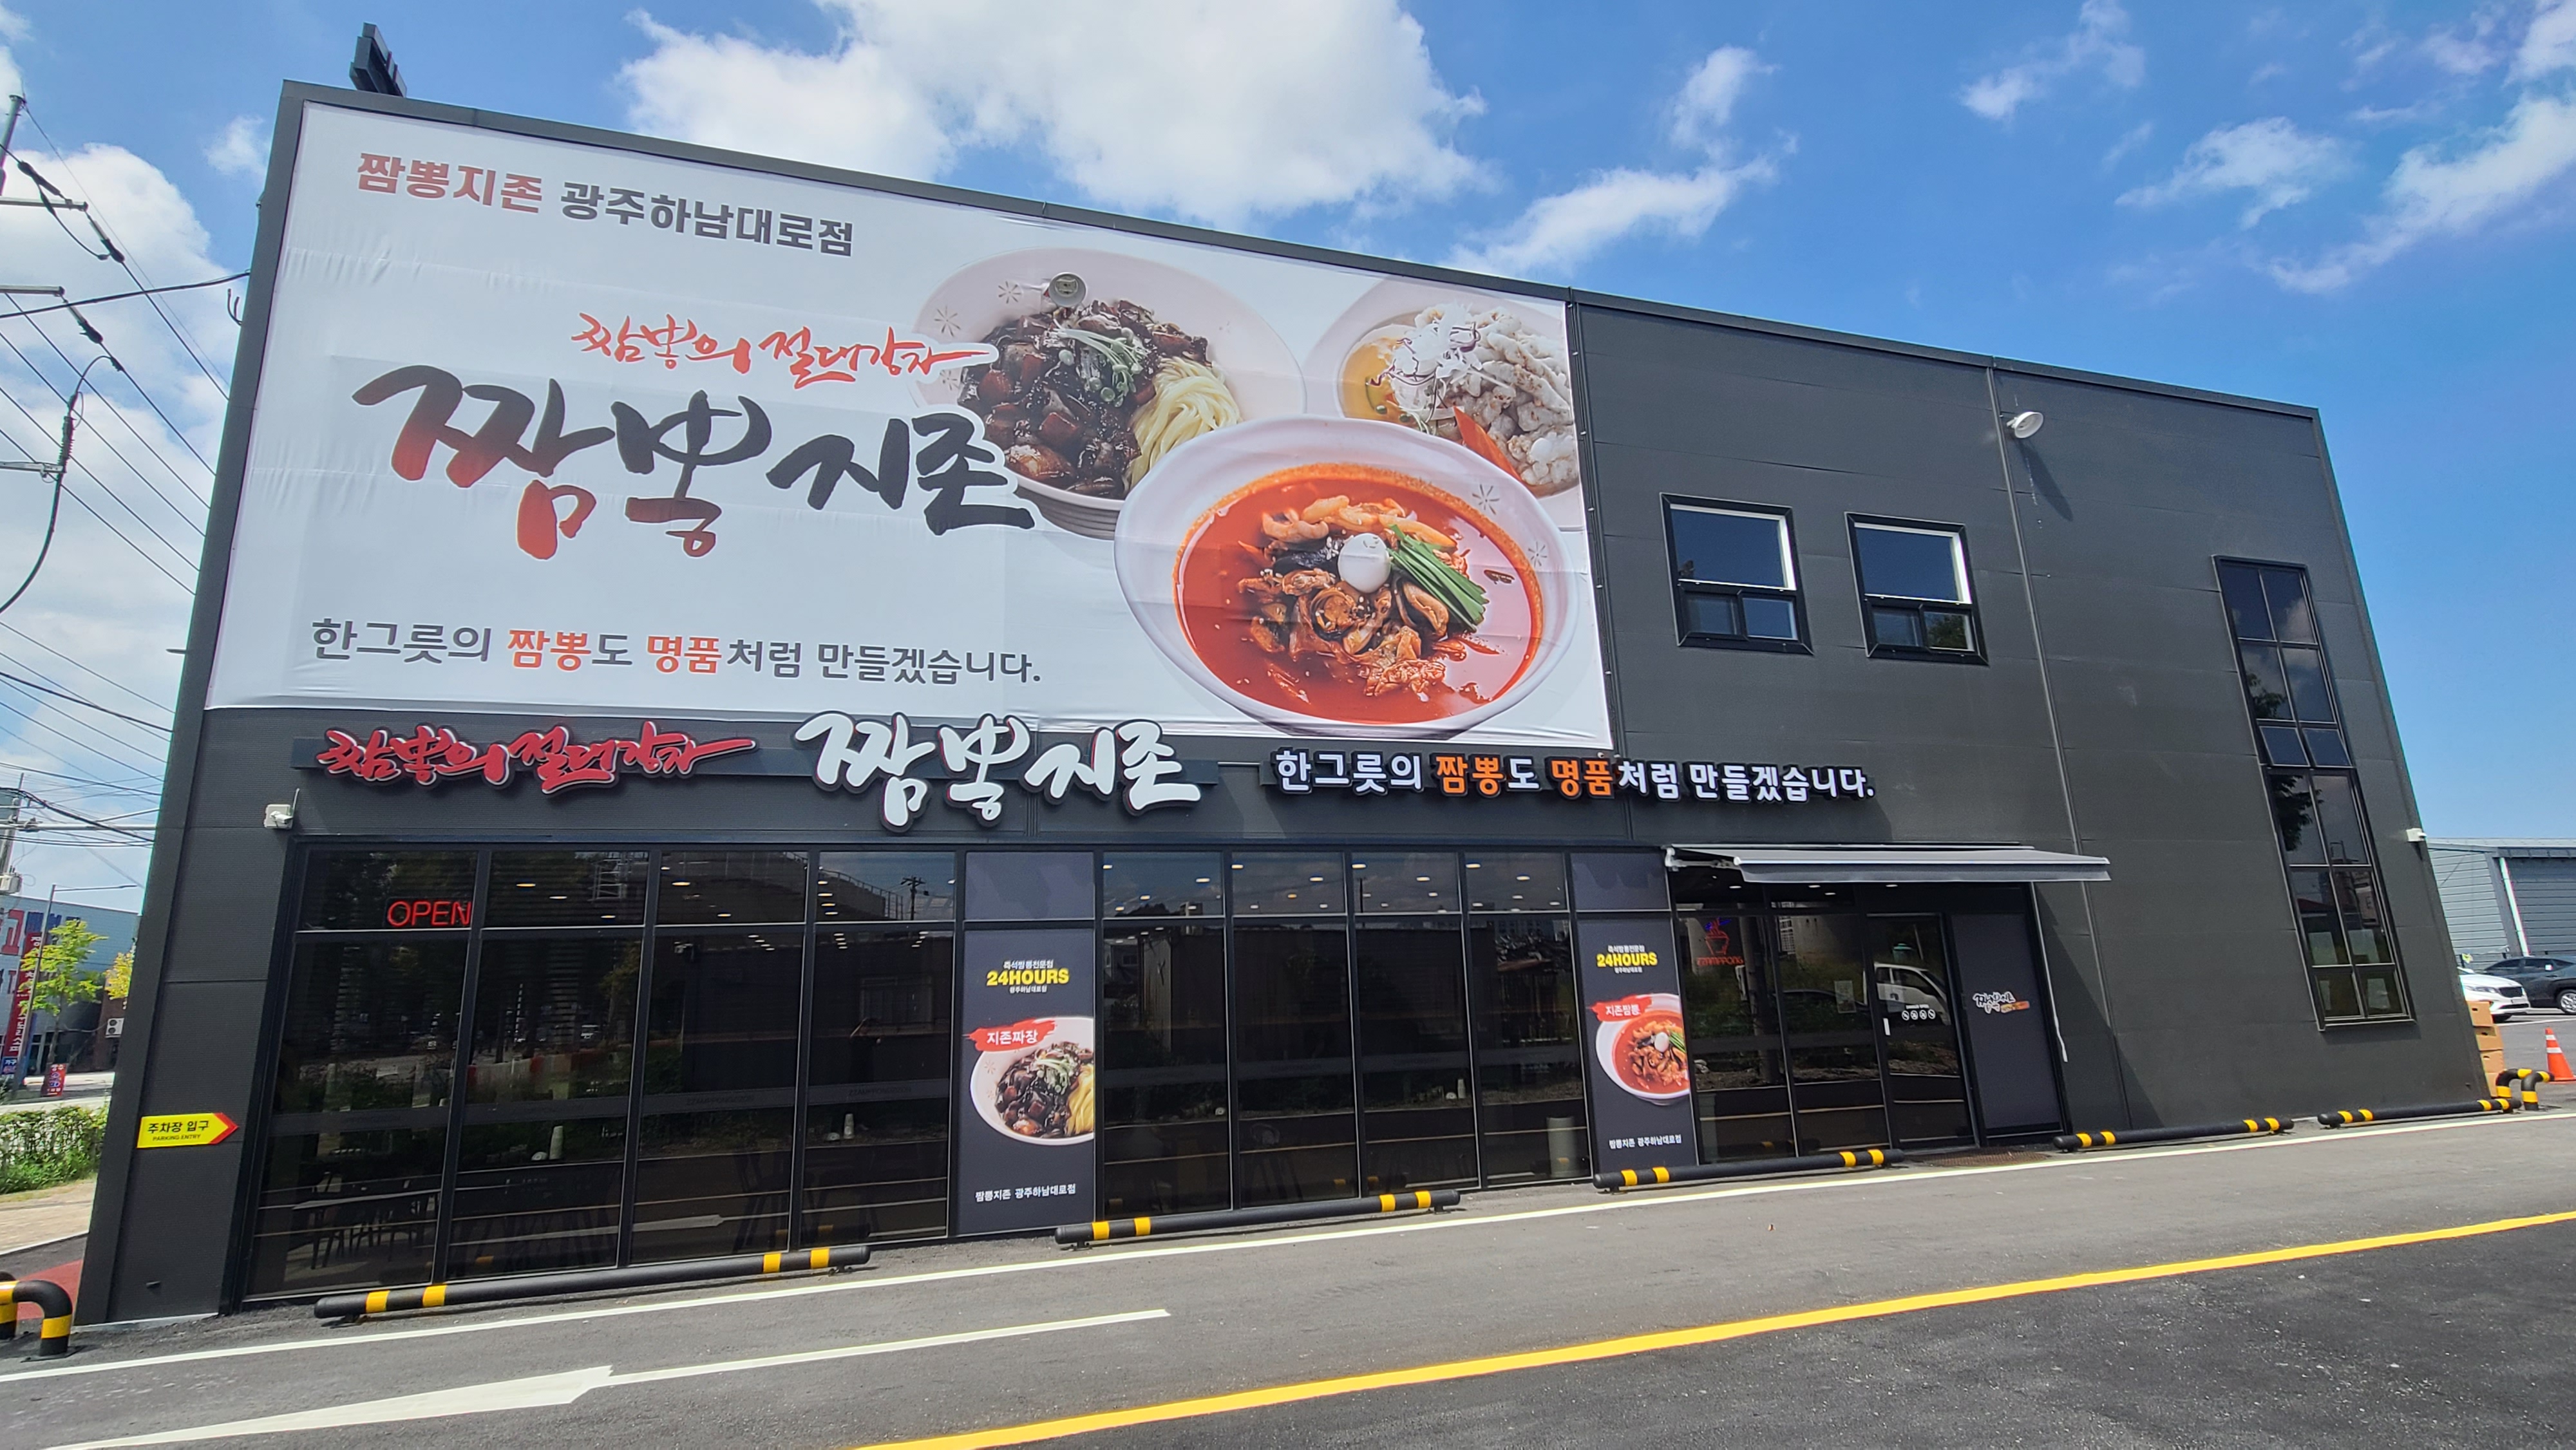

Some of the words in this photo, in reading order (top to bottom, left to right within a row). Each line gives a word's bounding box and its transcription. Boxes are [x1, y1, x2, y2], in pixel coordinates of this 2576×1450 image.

[357, 153, 542, 213] 짬뽕지존
[560, 181, 854, 256] 광주하남대로점
[571, 312, 750, 374] 짬뽕의
[758, 326, 989, 389] 절대강자
[352, 365, 1035, 560] 짬뽕지존
[312, 618, 492, 664] 한그릇의
[507, 629, 633, 672] 짬뽕도
[647, 636, 802, 679] 명품처럼
[817, 643, 1041, 685] 만들겠습니다.
[317, 725, 509, 786] 짬뽕의
[509, 721, 757, 794] 절대강자
[795, 713, 1202, 827] 짬뽕지존
[1275, 750, 1421, 793] 한그릇의
[1435, 755, 1540, 795] 짬뽕도
[1551, 759, 1680, 799] 명품처럼
[1690, 764, 1875, 802] 만들겠습니다.
[387, 901, 472, 927] OPEN
[986, 968, 1070, 986] 24HOURS
[1596, 952, 1658, 967] 24HOURS
[986, 1029, 1038, 1046] 지존짜장
[147, 1122, 183, 1134] 주차장
[187, 1120, 209, 1132] 입구
[975, 1189, 1012, 1203] 짬뽕지존
[1014, 1183, 1076, 1199] 광주하남대로점
